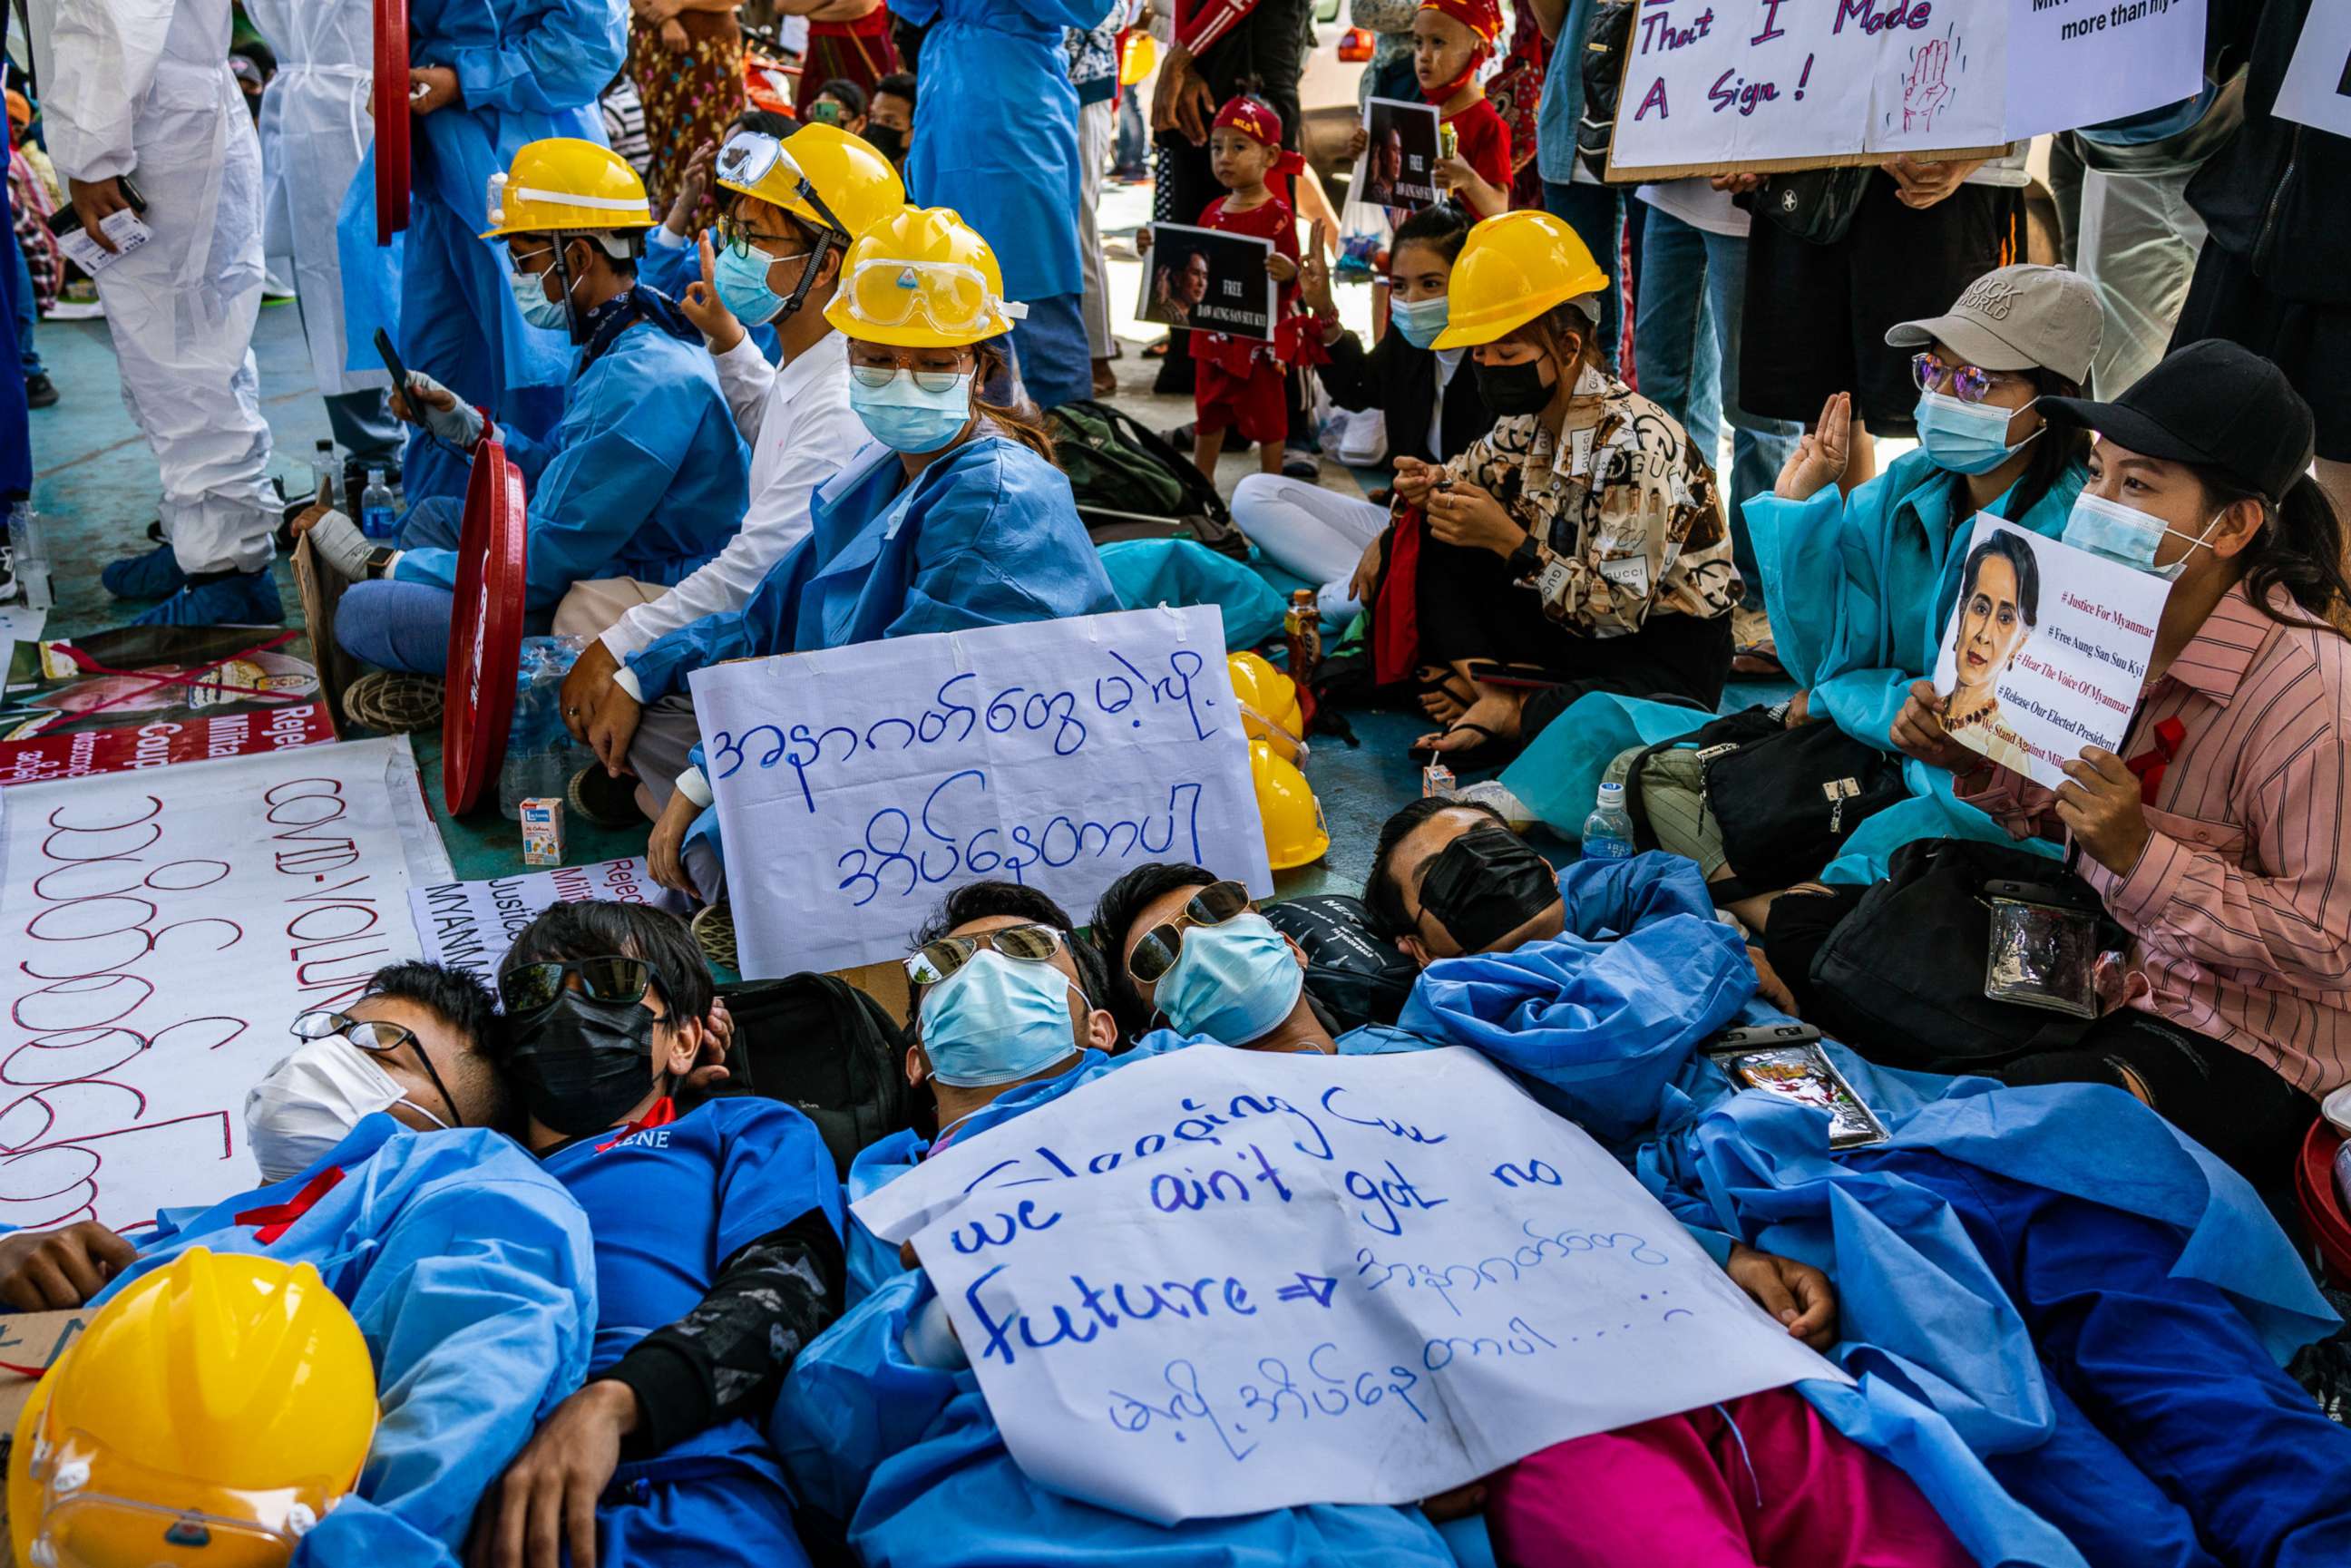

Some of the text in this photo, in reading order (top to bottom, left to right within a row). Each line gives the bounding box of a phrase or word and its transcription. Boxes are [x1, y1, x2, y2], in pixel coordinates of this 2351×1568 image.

[1642, 0, 1932, 54] That I Made
[2062, 14, 2107, 41] more
[2111, 0, 2147, 27] than
[1634, 76, 1669, 121] A
[1223, 279, 1243, 297] FREE
[1605, 569, 1644, 580] GUCCI
[2067, 593, 2095, 615] Justice
[2094, 604, 2112, 620] For
[2111, 610, 2154, 638] Myanmar
[2053, 627, 2072, 646] Free
[2071, 637, 2094, 658] Aung
[2093, 645, 2110, 662] San
[2109, 651, 2128, 669] Suu
[2127, 659, 2145, 678] Kyi
[2021, 654, 2042, 672] Hear
[2040, 662, 2056, 680] The
[2056, 670, 2078, 690] Voice
[2076, 680, 2092, 695] Of
[2089, 686, 2132, 715] Myanmar
[261, 705, 317, 752] Rejec
[1994, 726, 2016, 745] Stand
[2015, 735, 2046, 759] Against
[2003, 687, 2031, 710] Release
[2030, 700, 2048, 717] Our
[2046, 708, 2078, 733] Elected
[2075, 723, 2116, 752] President
[123, 722, 183, 770] Coup
[264, 778, 390, 1014] COVID-VOLUN
[551, 867, 594, 904] Milit
[615, 1131, 671, 1149] ENE
[951, 1143, 1564, 1254] we ain't got no
